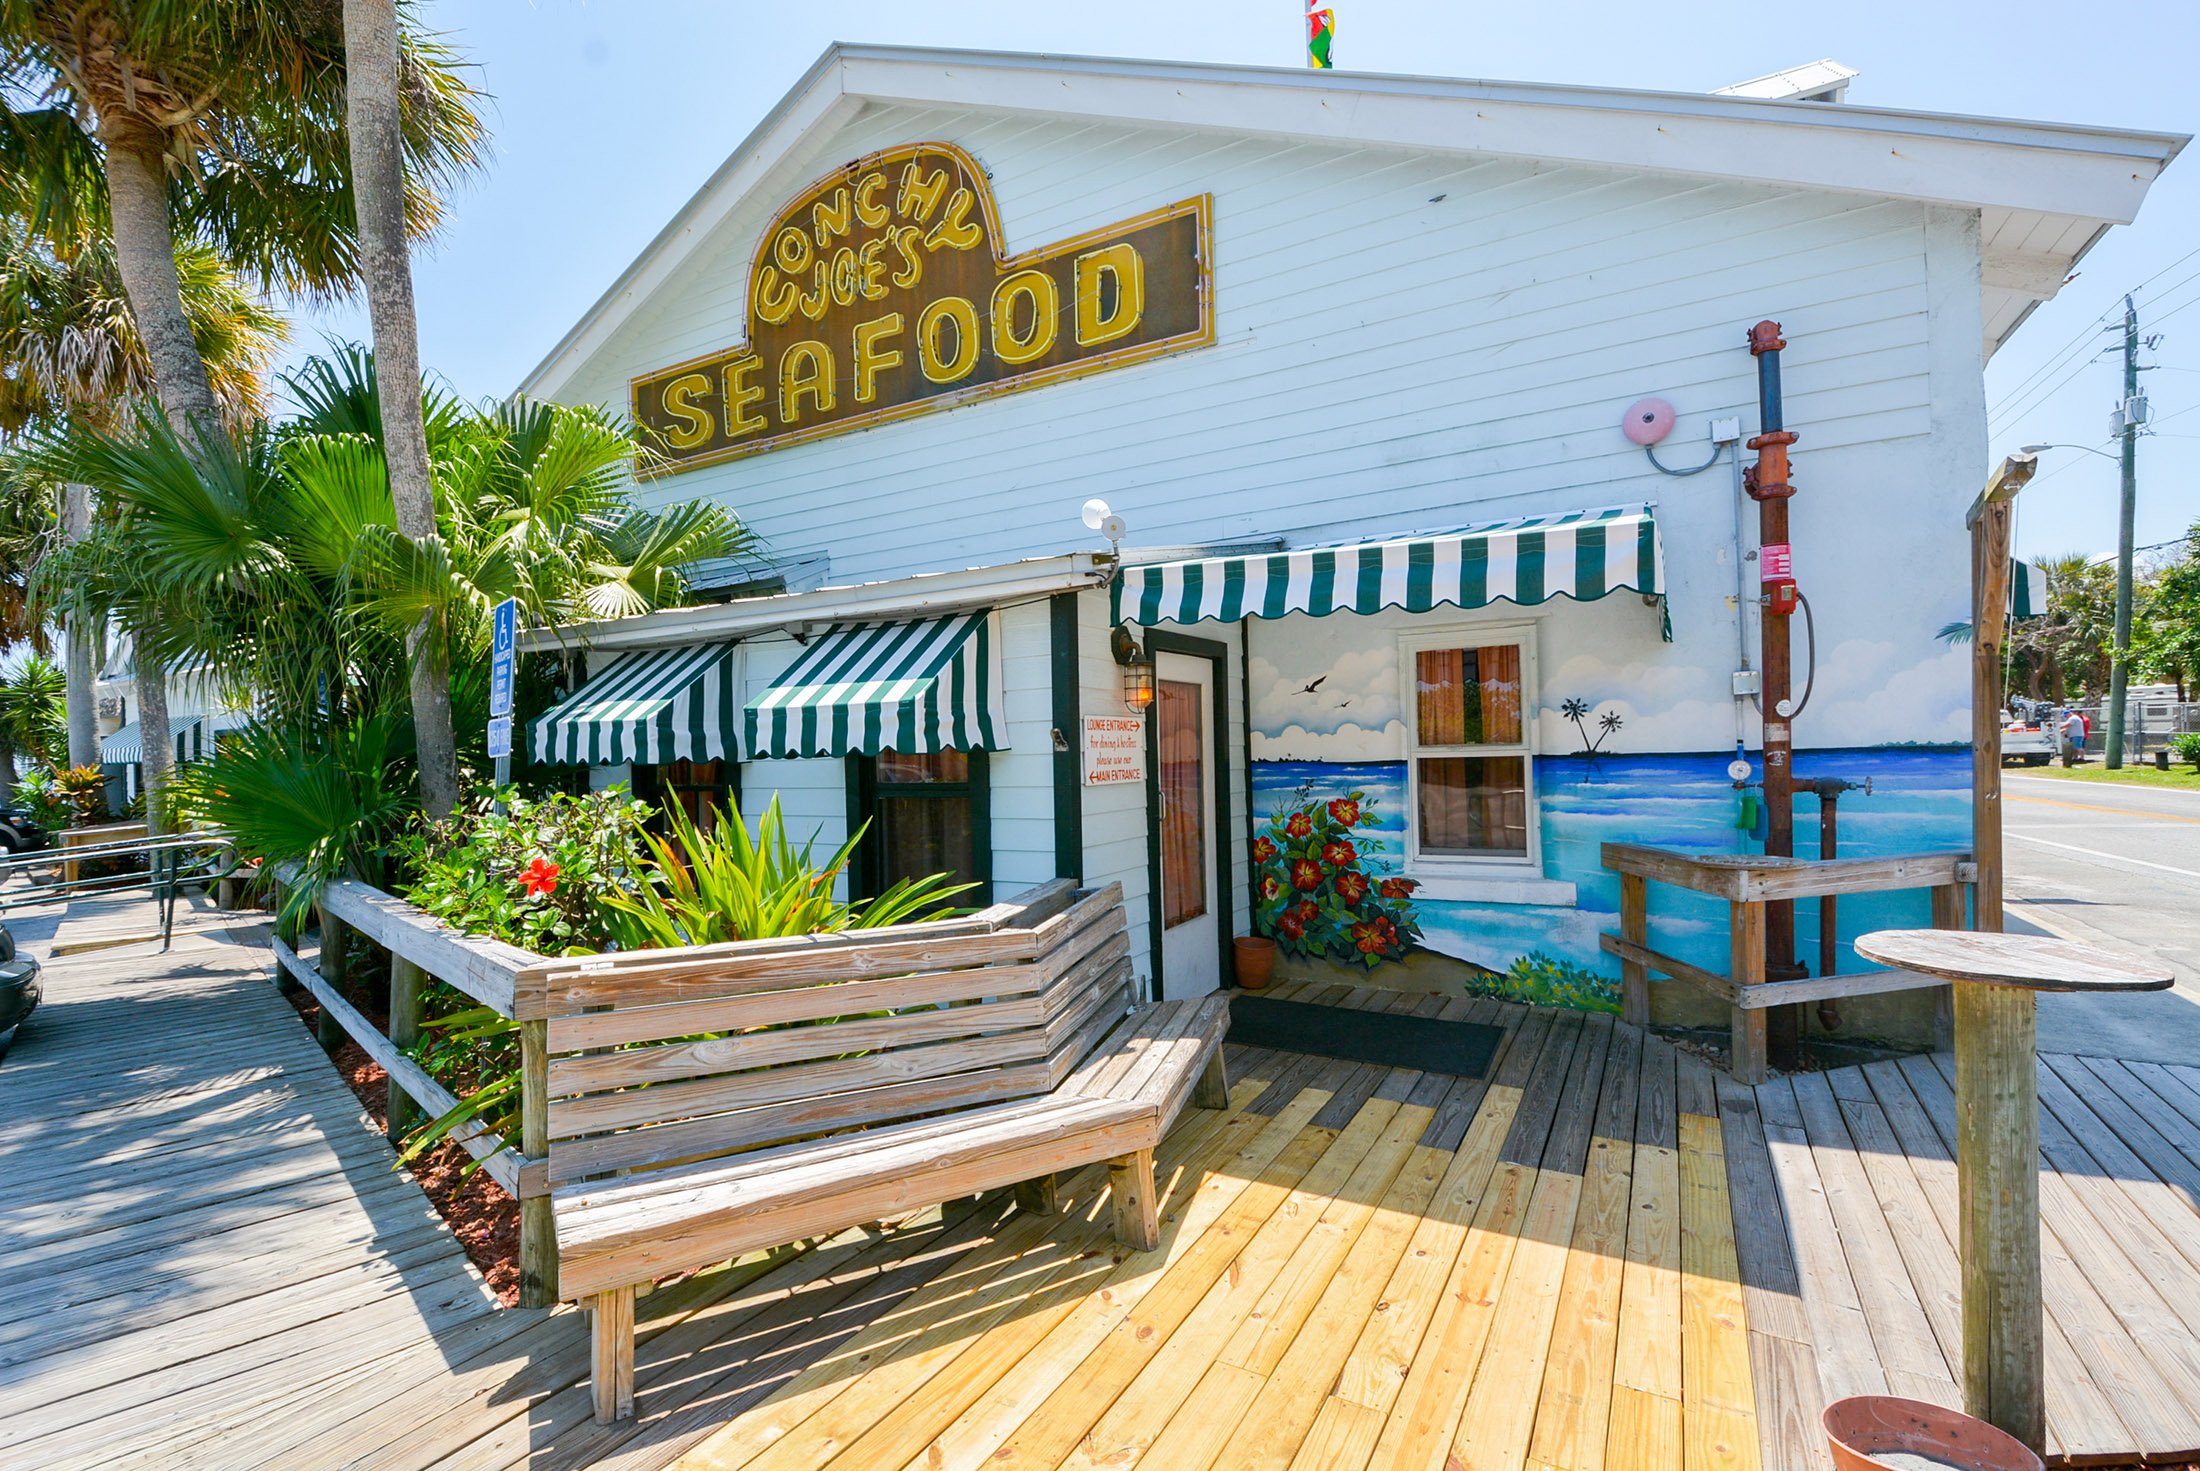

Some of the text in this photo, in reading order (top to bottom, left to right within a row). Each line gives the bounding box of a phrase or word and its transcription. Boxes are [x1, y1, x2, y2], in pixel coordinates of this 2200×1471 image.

[755, 162, 984, 325] CONCHY
[799, 224, 924, 321] JOE'S
[661, 242, 1145, 450] SEAFOOD
[1087, 719, 1133, 732] LOUNGE ENTRANCE
[1090, 735, 1098, 748] for
[1099, 734, 1116, 751] dining
[1120, 735, 1137, 748] hostess
[1096, 752, 1112, 768] please
[1113, 757, 1122, 765] use
[1097, 769, 1140, 781] MAIN ENTRANCE
